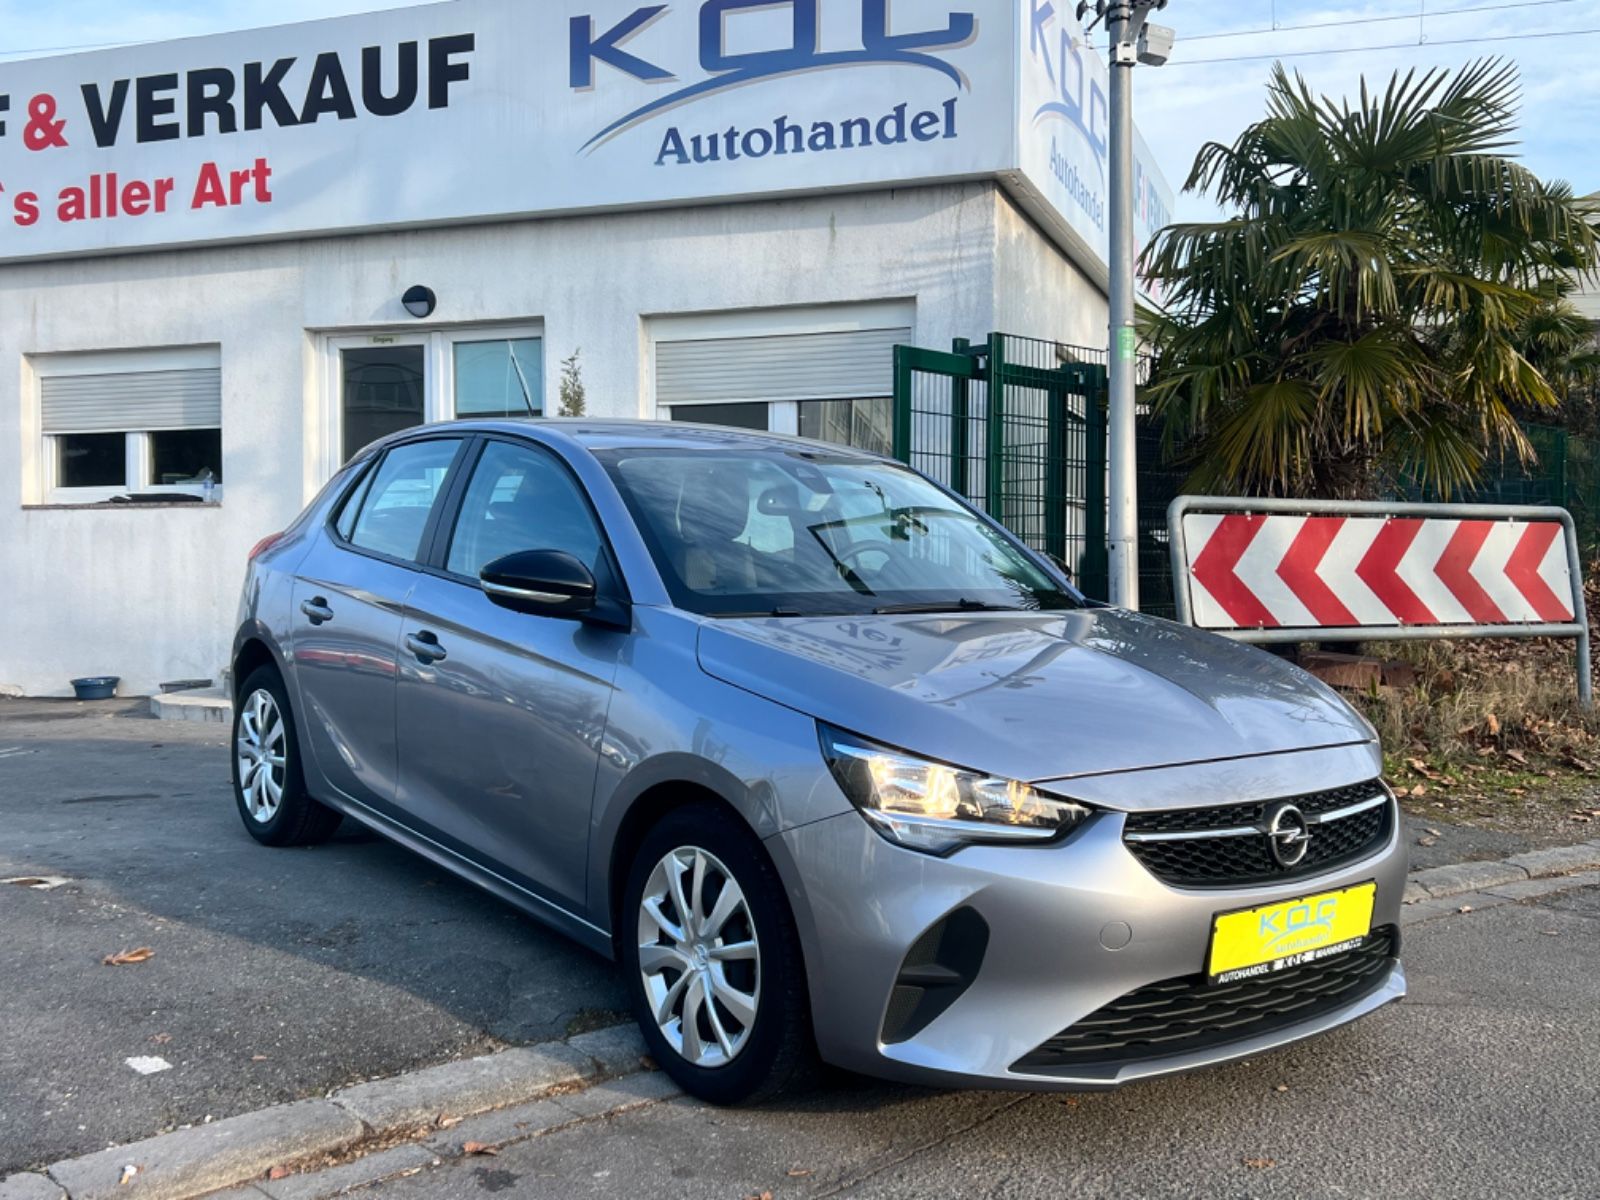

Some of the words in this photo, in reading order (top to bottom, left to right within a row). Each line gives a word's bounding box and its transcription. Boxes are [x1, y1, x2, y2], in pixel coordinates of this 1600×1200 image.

[23, 93, 69, 151] &
[81, 33, 475, 148] VERKAUF
[654, 97, 958, 166] Autohandel
[57, 172, 174, 222] aller
[191, 158, 272, 209] Art
[1049, 135, 1104, 233] Autohandel
